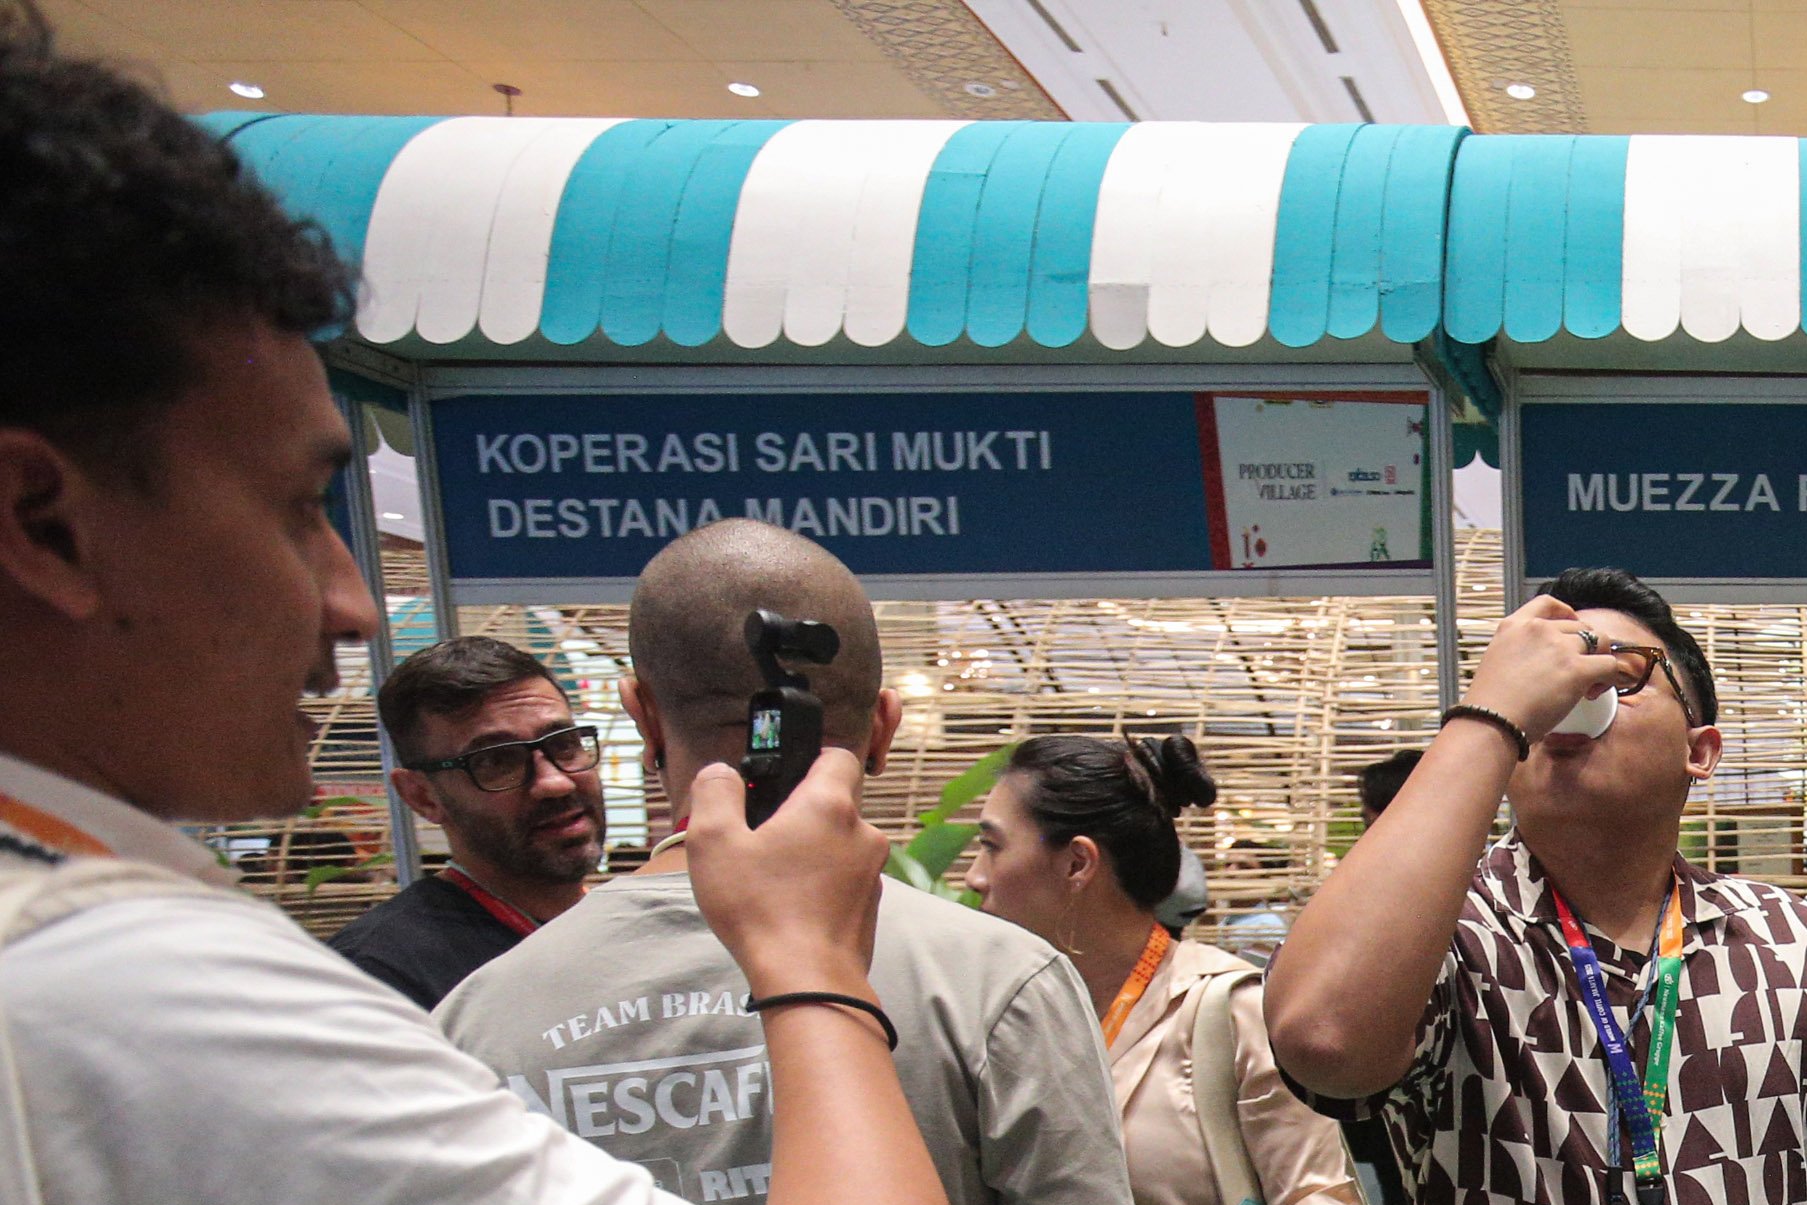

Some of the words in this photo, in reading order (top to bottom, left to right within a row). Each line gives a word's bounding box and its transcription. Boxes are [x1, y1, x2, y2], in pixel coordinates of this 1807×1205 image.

[476, 433, 740, 474] KOPERASI
[755, 432, 878, 472] SARI
[891, 430, 1052, 471] MUKTI
[1239, 463, 1315, 480] PRODUCER
[1258, 484, 1316, 500] VILLAGE
[1567, 473, 1781, 512] MUEZZA
[488, 498, 722, 538] DESTANA
[744, 496, 960, 537] MANDIRI
[542, 996, 651, 1050] TEAM
[662, 991, 760, 1019] BRAS
[507, 1046, 774, 1138] NESCAF
